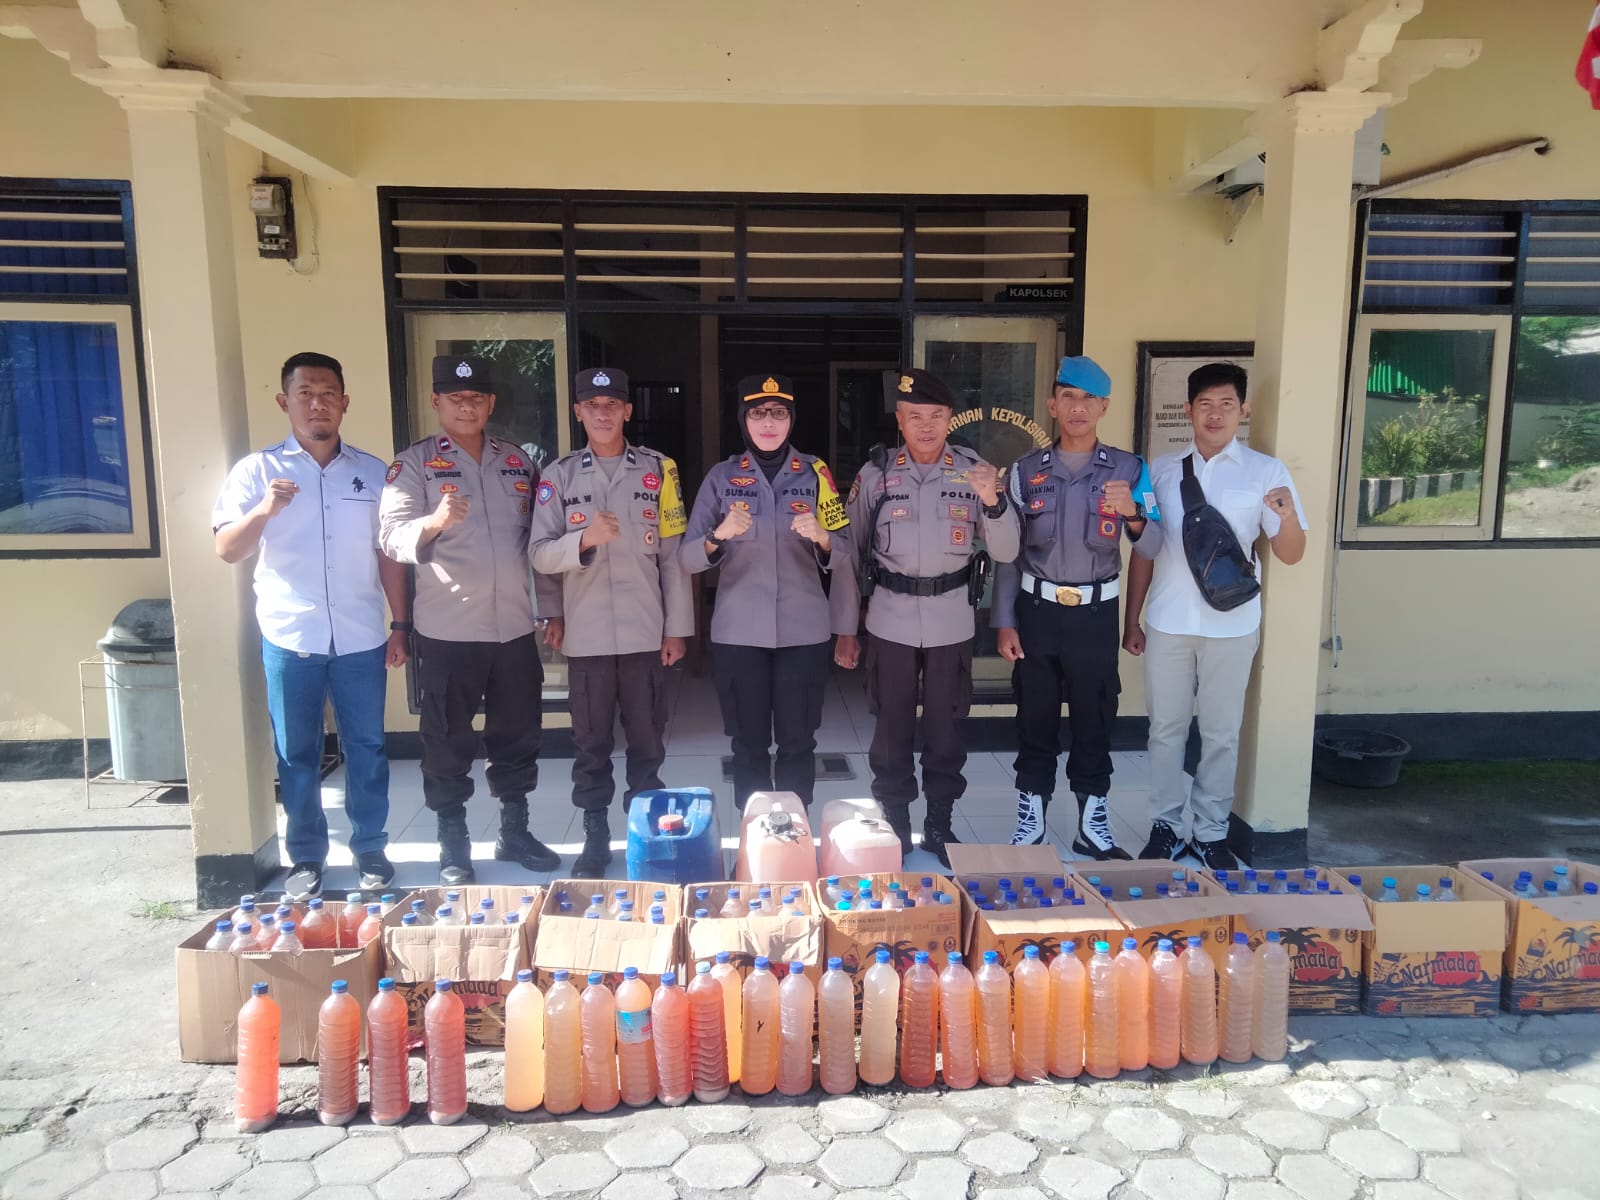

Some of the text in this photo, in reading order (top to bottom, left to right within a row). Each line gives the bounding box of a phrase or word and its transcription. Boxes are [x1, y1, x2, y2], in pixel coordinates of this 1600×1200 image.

[1009, 287, 1068, 298] KAPOLSEK
[947, 407, 1053, 449] YANAN KEPOLISIAN
[725, 488, 758, 498] SUSAN
[782, 488, 815, 498] POLRI
[941, 491, 976, 501] POLRI
[1292, 947, 1339, 970] mada
[1399, 951, 1477, 987] Narmada
